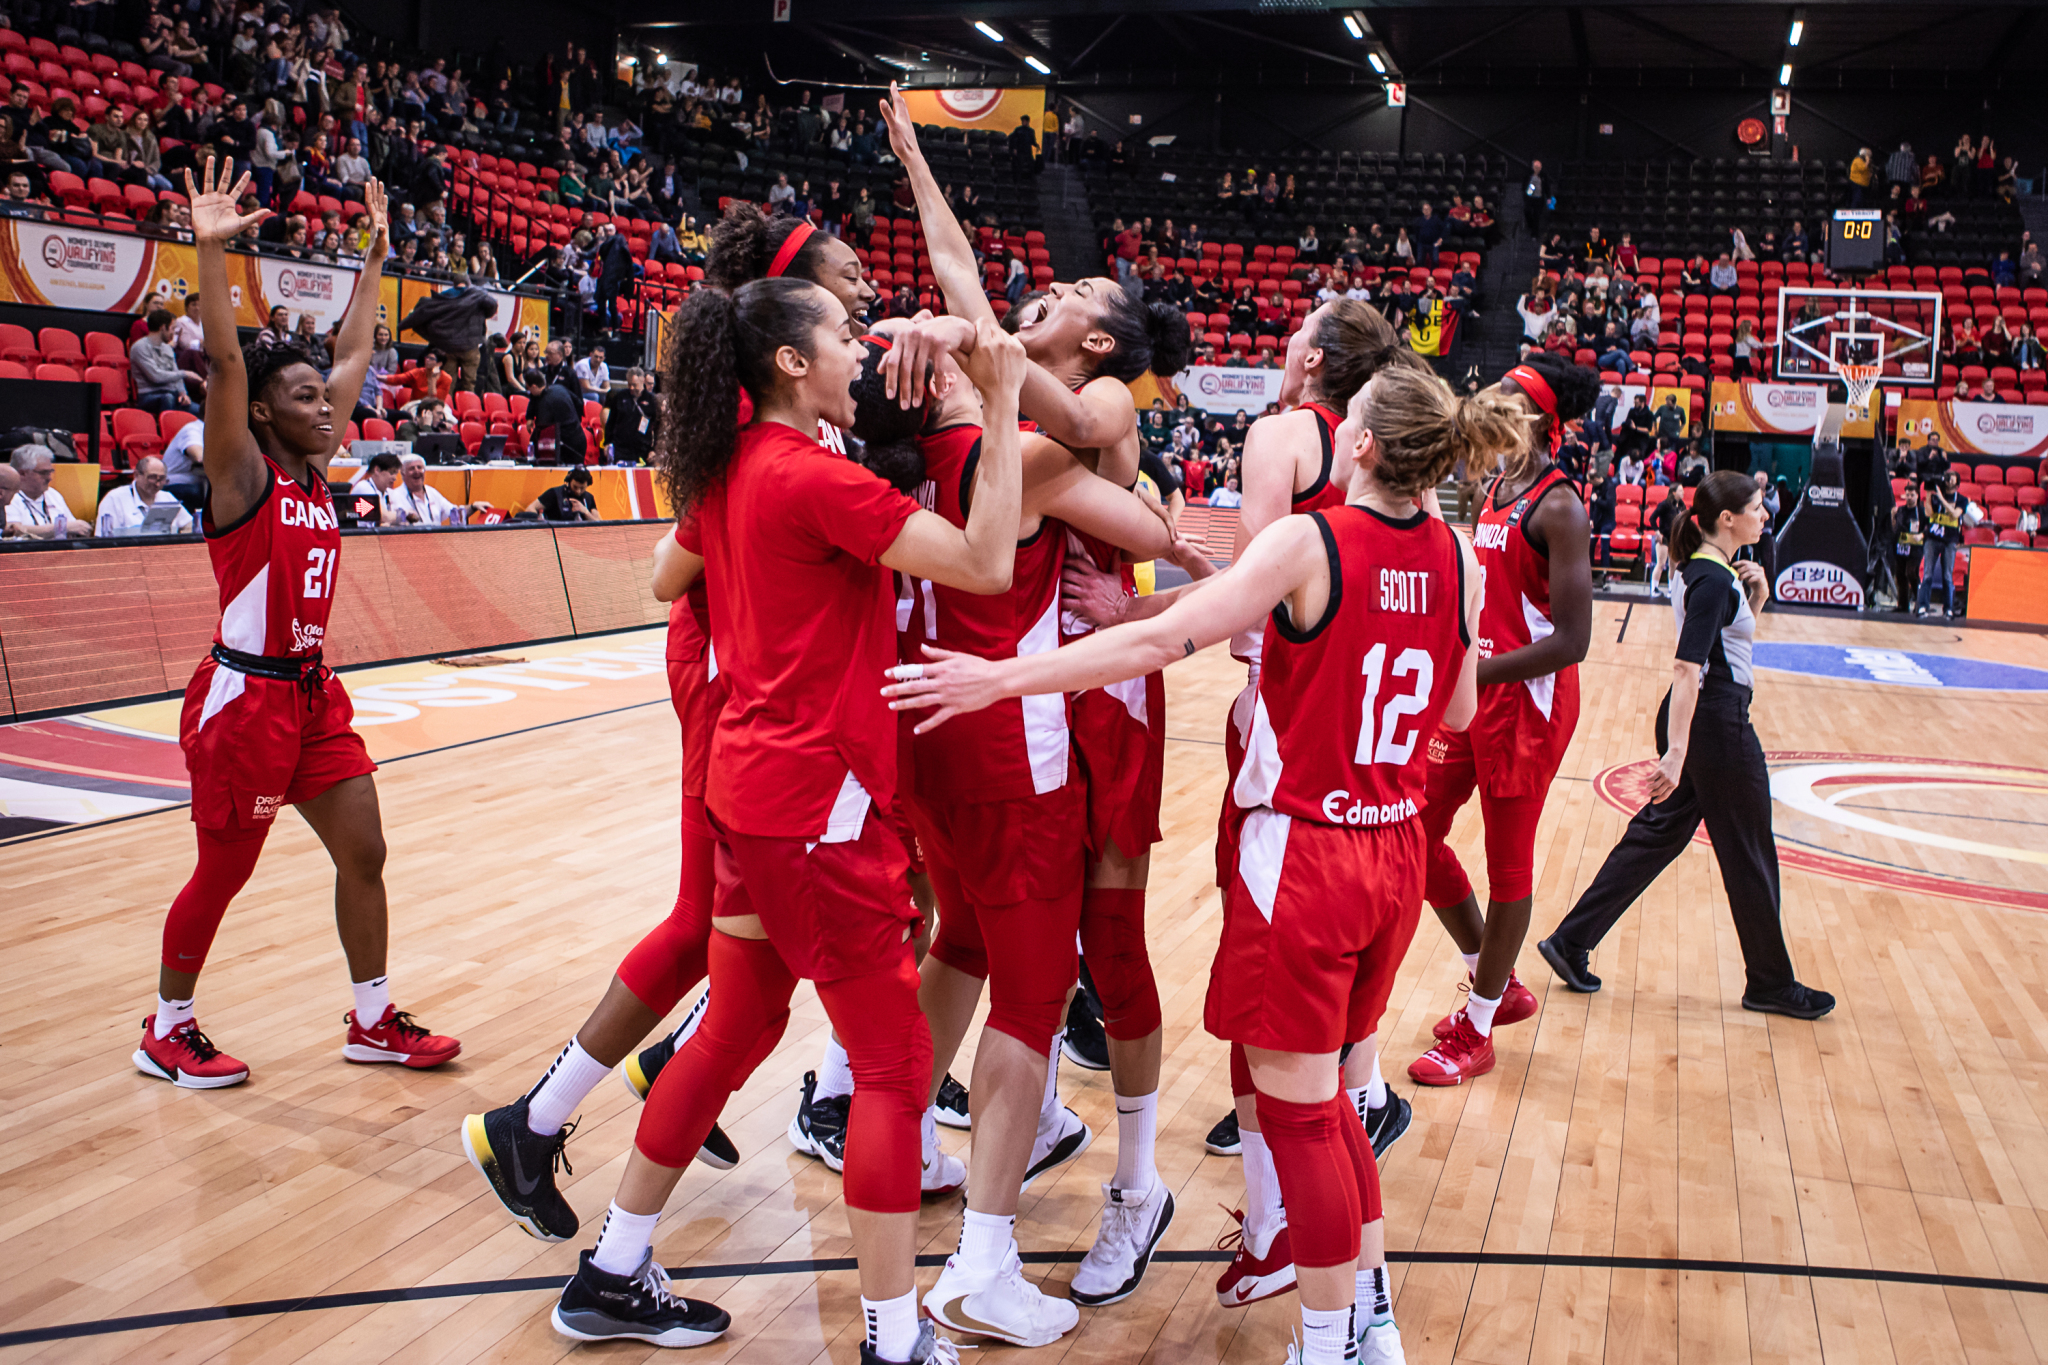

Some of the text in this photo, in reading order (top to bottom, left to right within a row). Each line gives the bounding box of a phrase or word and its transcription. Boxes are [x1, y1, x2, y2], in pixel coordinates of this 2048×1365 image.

[1843, 221, 1873, 239] 0:0
[303, 548, 337, 598] 21
[1380, 568, 1429, 614] SCOTT
[1791, 567, 1844, 583] 百岁山
[1354, 642, 1434, 765] 12
